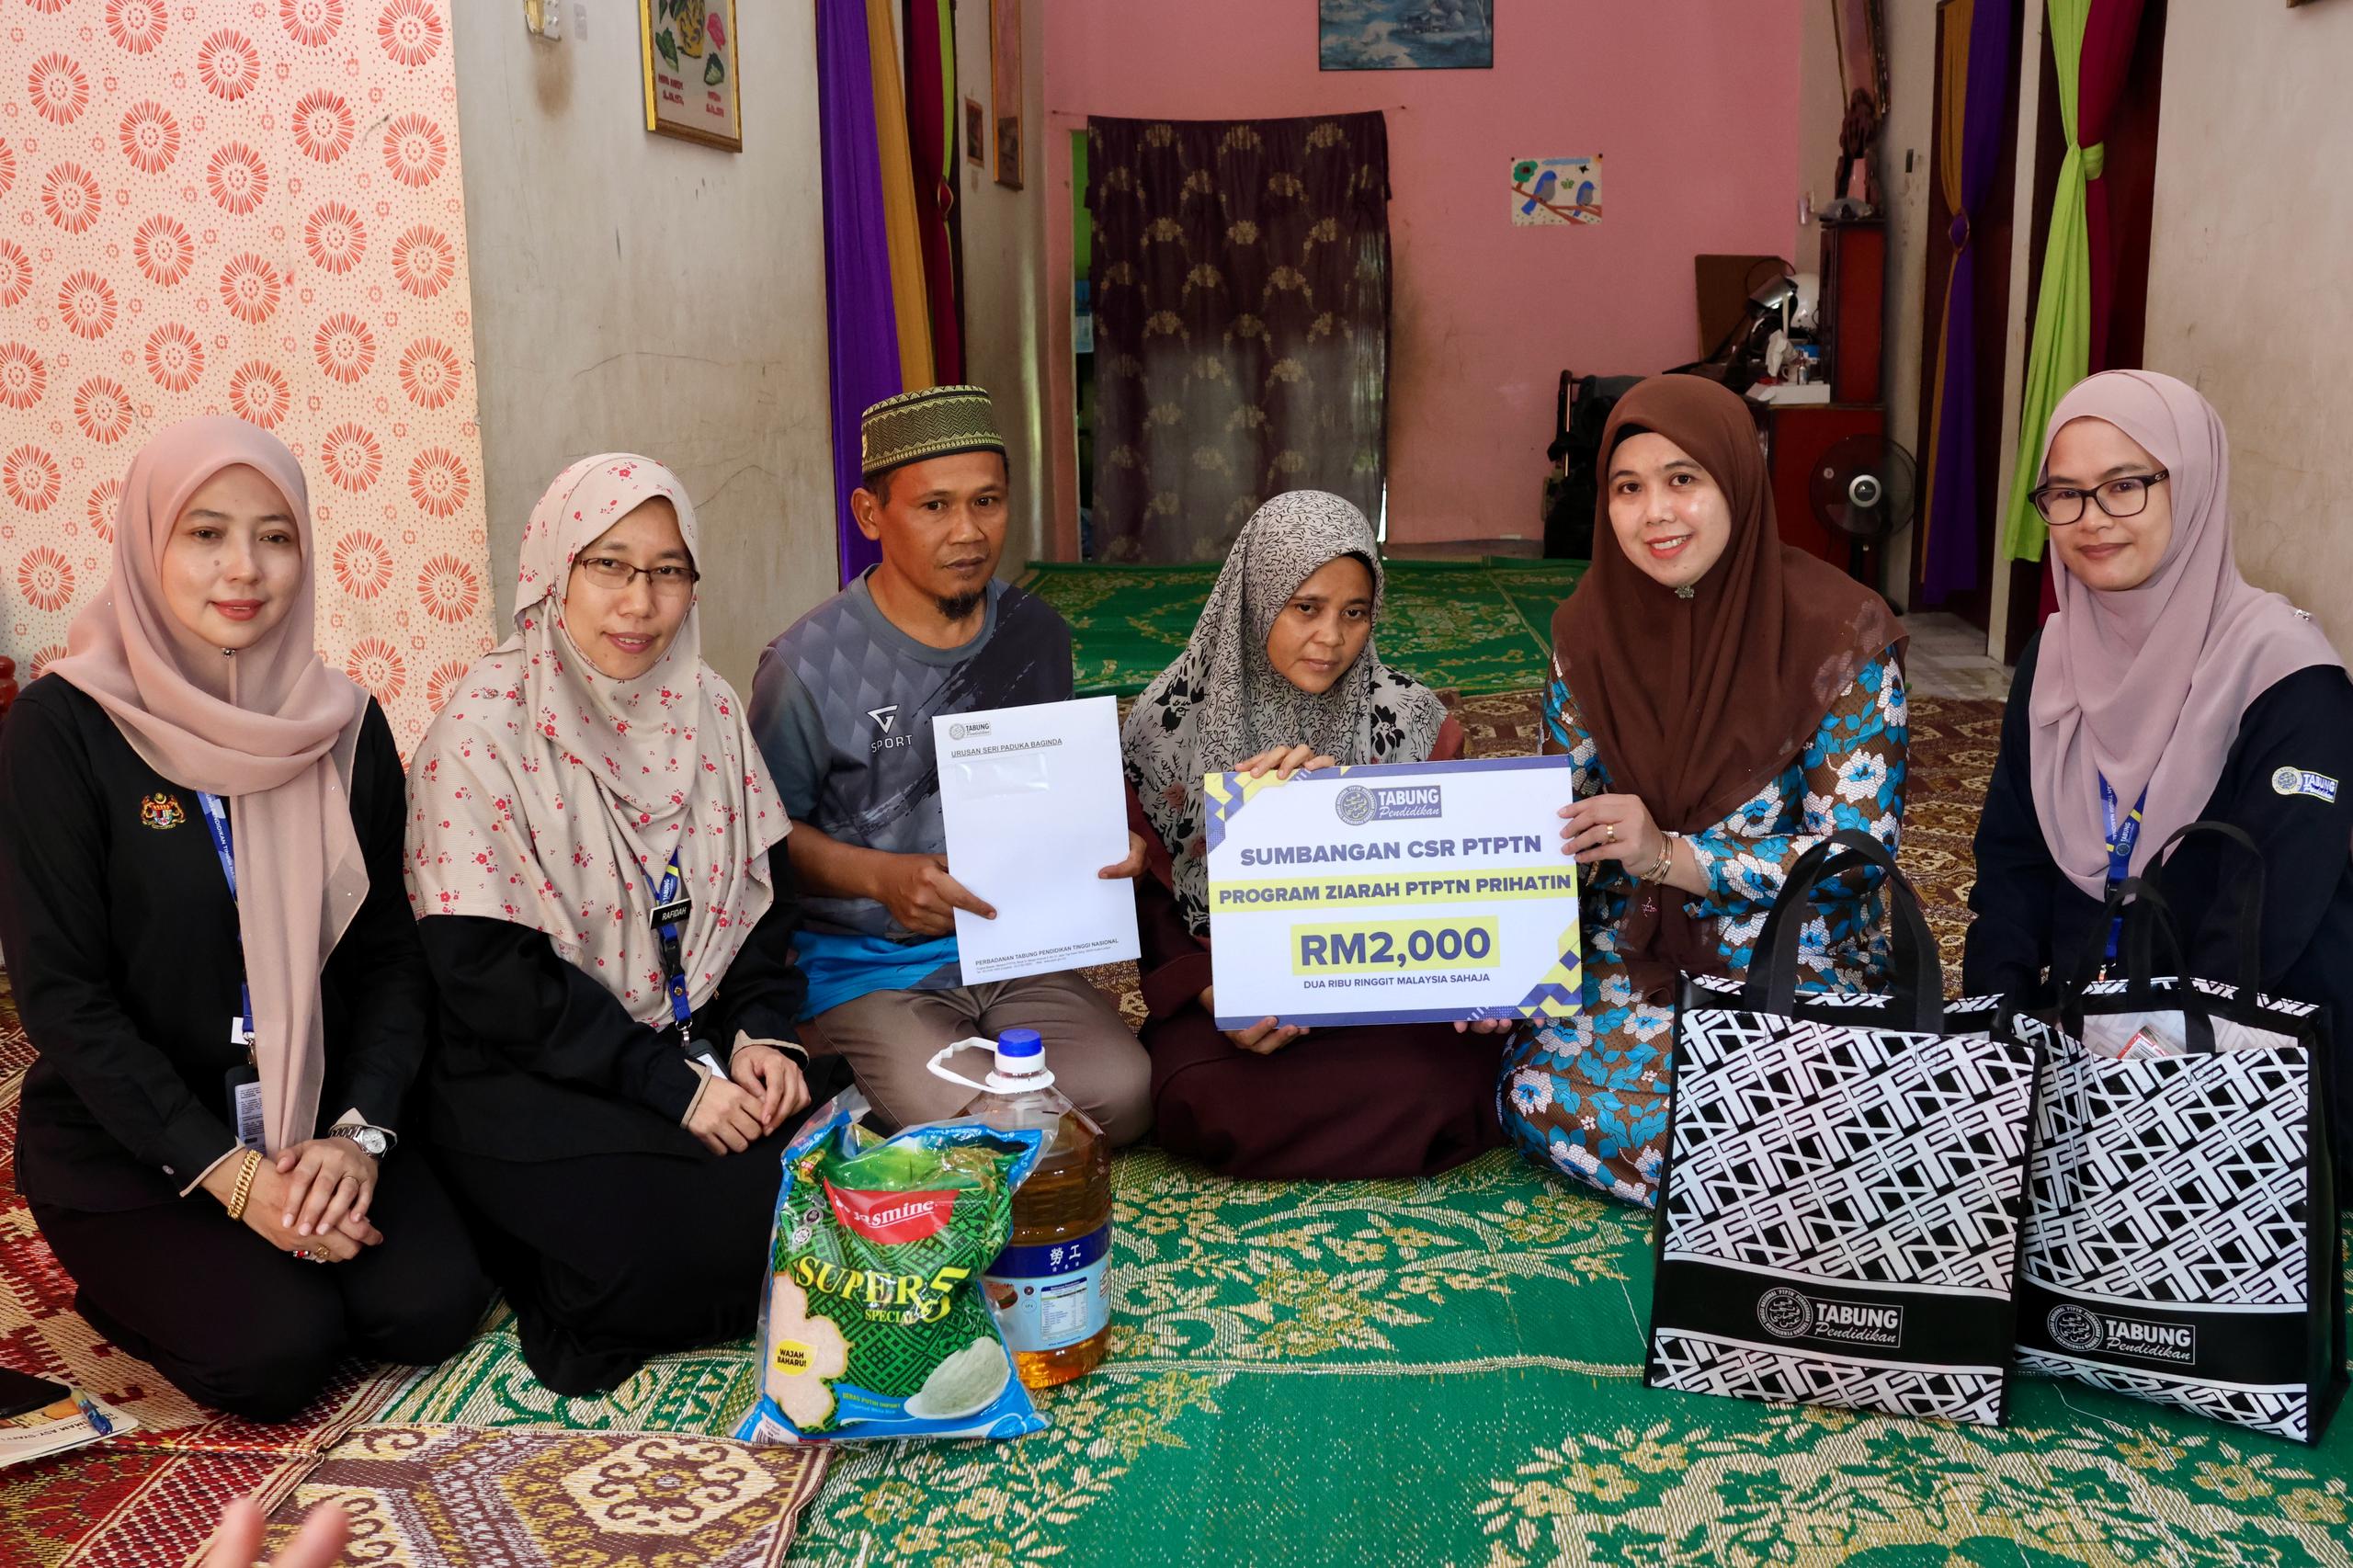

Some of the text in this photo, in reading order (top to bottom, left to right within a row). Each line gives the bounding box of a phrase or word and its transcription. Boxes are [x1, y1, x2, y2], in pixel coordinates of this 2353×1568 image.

[965, 723, 990, 732] TABUNG
[871, 735, 913, 753] SPORT
[951, 738, 1063, 757] URUSAN SERI PADUKA BAGINDA
[2303, 774, 2336, 792] TABUNG
[1378, 789, 1439, 806] TABUNG
[1379, 804, 1440, 819] Pendidikan
[2120, 822, 2131, 842] TABUNG
[1240, 835, 1542, 867] SUMBANGAN CSR PTPTN
[1219, 874, 1572, 905] PROGRAM ZIARAH PTPTN PRIHATIN
[662, 906, 687, 921] RAFIDAH
[975, 955, 1015, 966] PERBADANAN
[1015, 950, 1038, 960] TABUNG
[1039, 946, 1072, 956] PENDIDIKAN
[1073, 942, 1091, 950] TINGGI
[1091, 937, 1119, 947] NASIONAL
[1301, 926, 1491, 968] RM2,000
[1303, 973, 1490, 989] DUA RIBU RINGGIT MALAYSIA SAHAJA
[1050, 1244, 1082, 1267] 勞工
[796, 1256, 972, 1324] SUPER 5
[1816, 1302, 1898, 1329] TABUNG
[1814, 1322, 1897, 1343] Pendidikan
[2105, 1320, 2191, 1347] TABUNG
[779, 1348, 804, 1359] WAJAH
[2106, 1336, 2191, 1360] Pendidikan
[777, 1356, 807, 1369] BAHARU!
